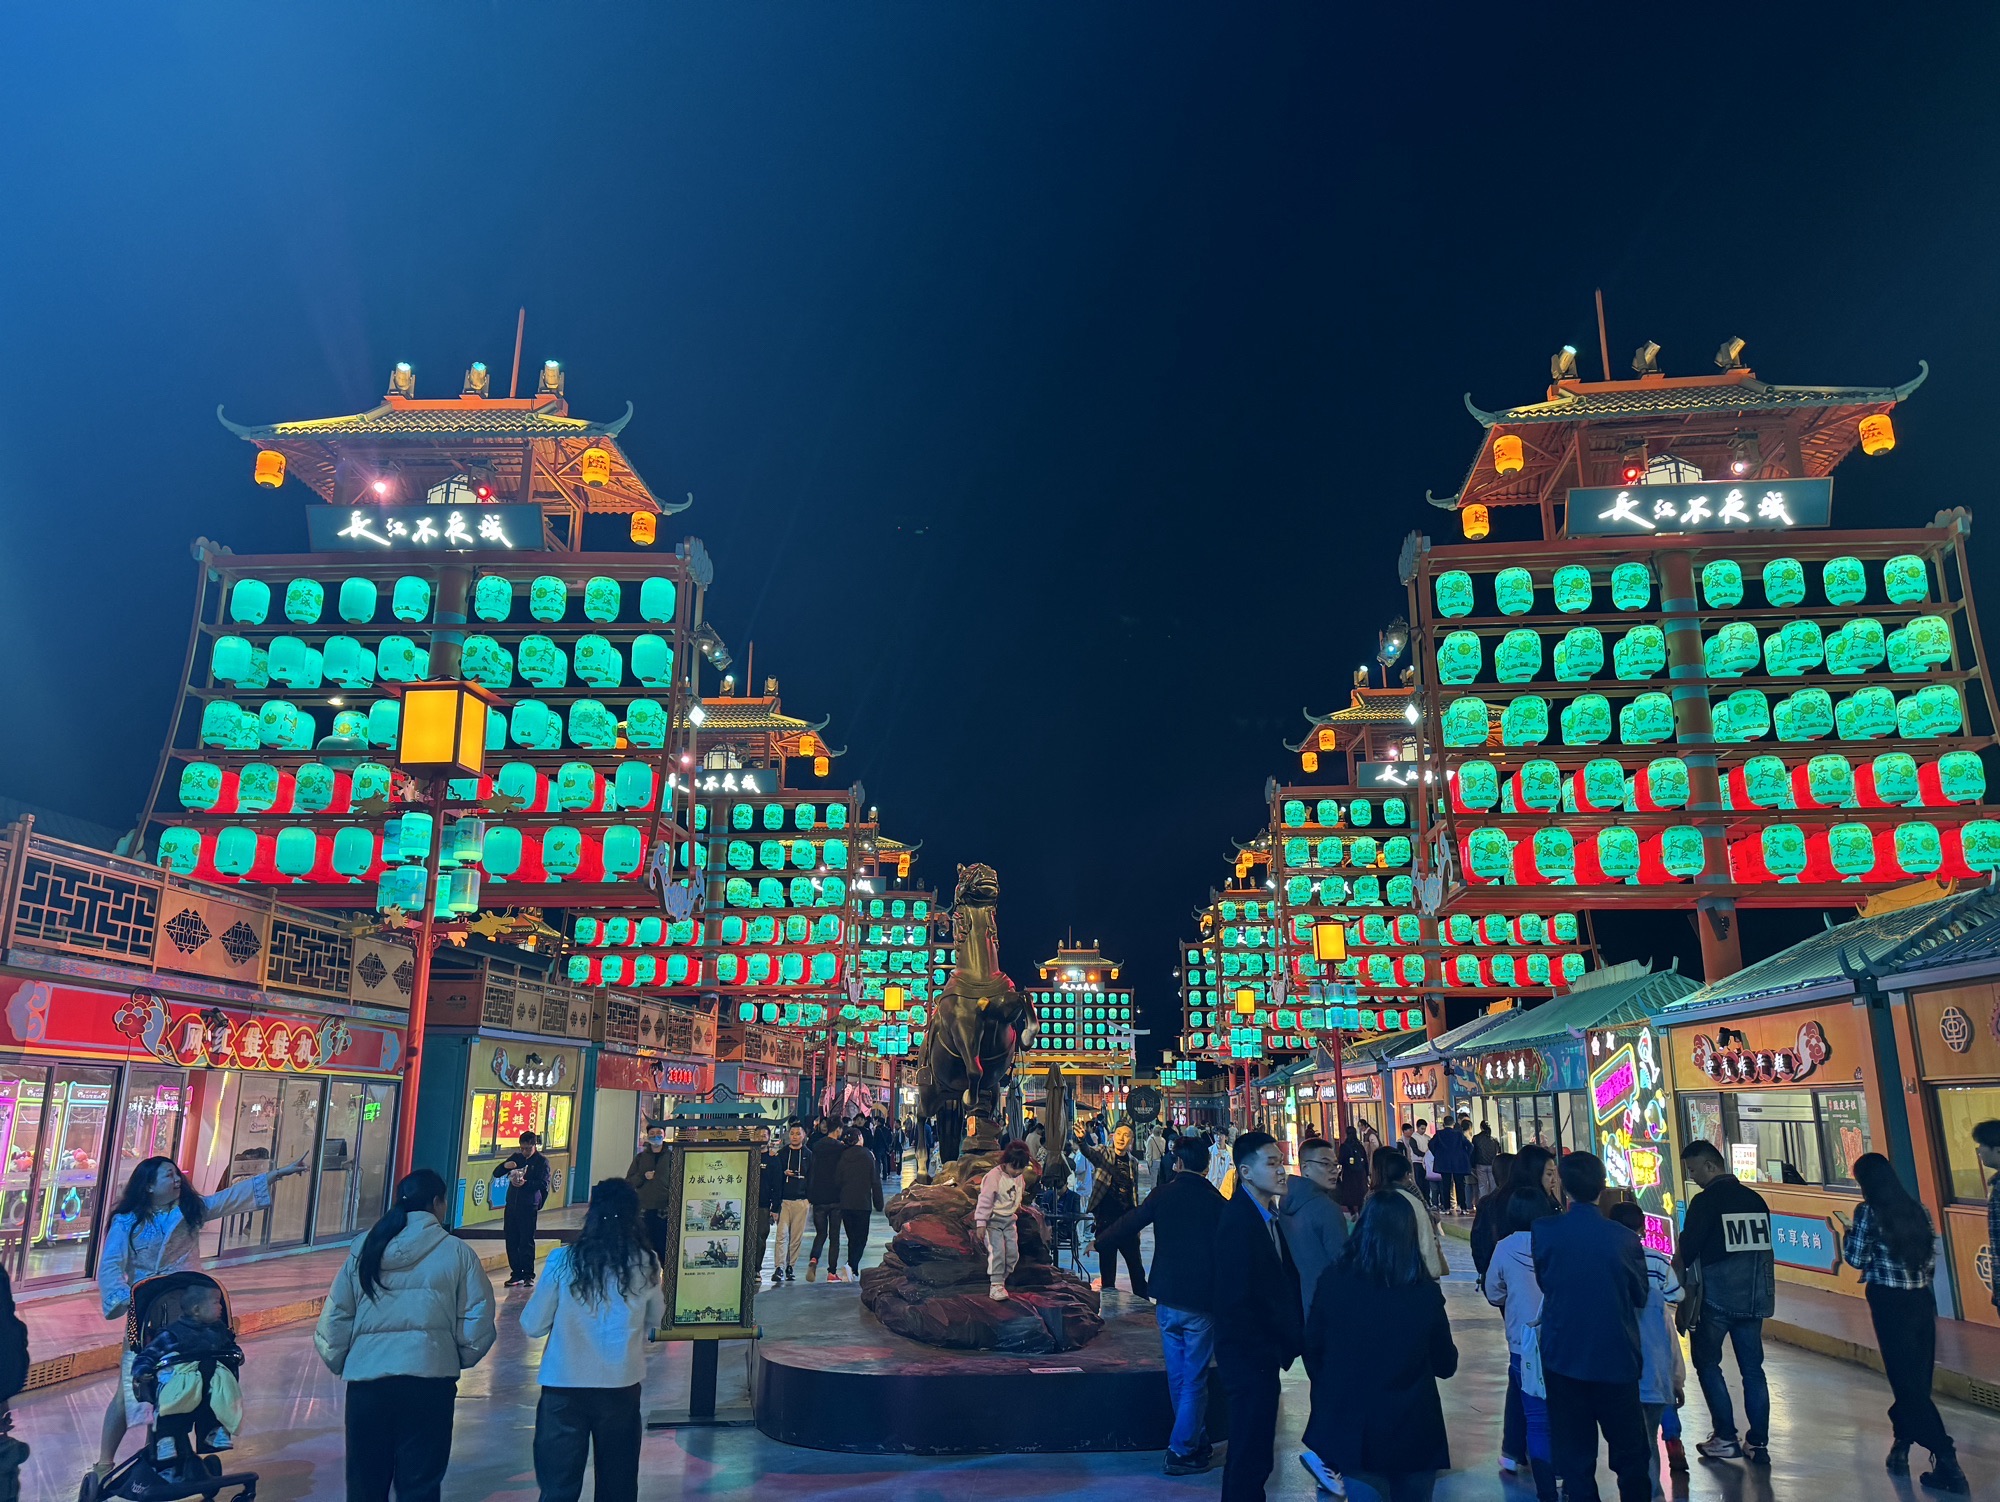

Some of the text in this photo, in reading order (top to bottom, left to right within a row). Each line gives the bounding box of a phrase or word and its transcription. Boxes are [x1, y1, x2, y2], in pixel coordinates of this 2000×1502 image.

[1598, 488, 1793, 529] 长江不夜城
[337, 510, 513, 548] 长江不夜城
[181, 1022, 314, 1064] 网红娃娃机
[1706, 1053, 1785, 1077] 空气炸年糕
[512, 1092, 525, 1125] 牛蛙
[688, 1175, 743, 1185] 力拔山兮舞台
[1726, 1219, 1770, 1245] MH
[1777, 1227, 1822, 1250] 乐享食尚
